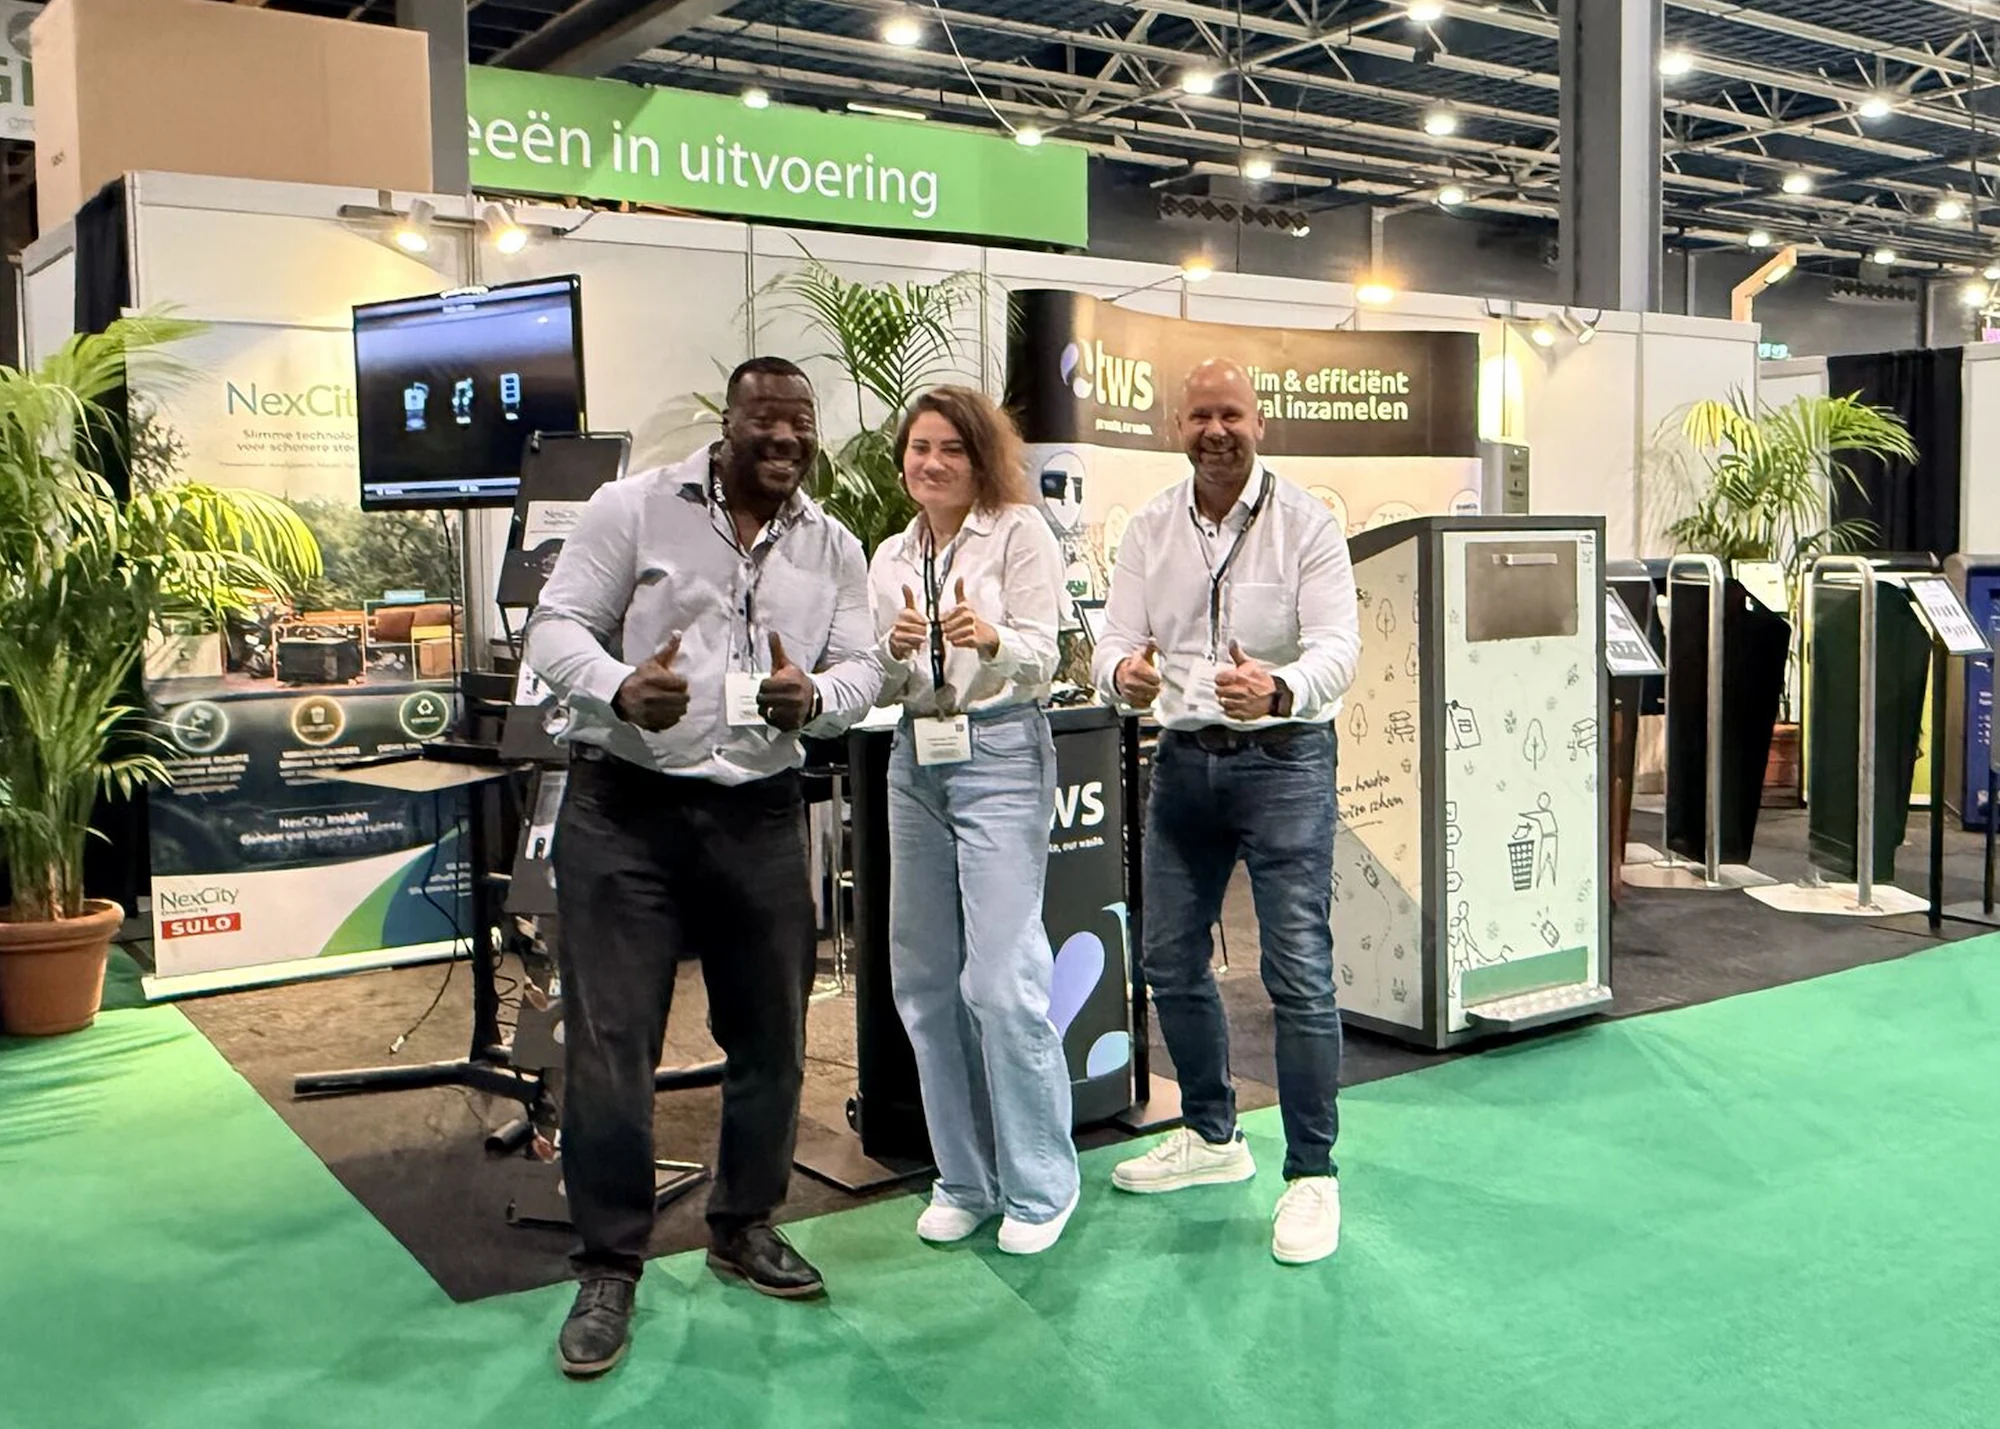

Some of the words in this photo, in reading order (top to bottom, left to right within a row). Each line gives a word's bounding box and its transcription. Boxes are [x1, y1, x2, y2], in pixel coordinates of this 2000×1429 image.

[612, 119, 660, 177] in
[680, 132, 939, 220] uitvoering
[1095, 339, 1154, 412] tws
[1247, 365, 1281, 393] im
[1283, 368, 1302, 393] &
[1305, 367, 1410, 395] efficiënt
[226, 380, 355, 419] NexCit
[1257, 393, 1283, 419] al
[1286, 394, 1410, 421] inzamelen
[1049, 781, 1105, 829] ws
[160, 886, 240, 910] NexCity
[170, 915, 232, 937] SULO
